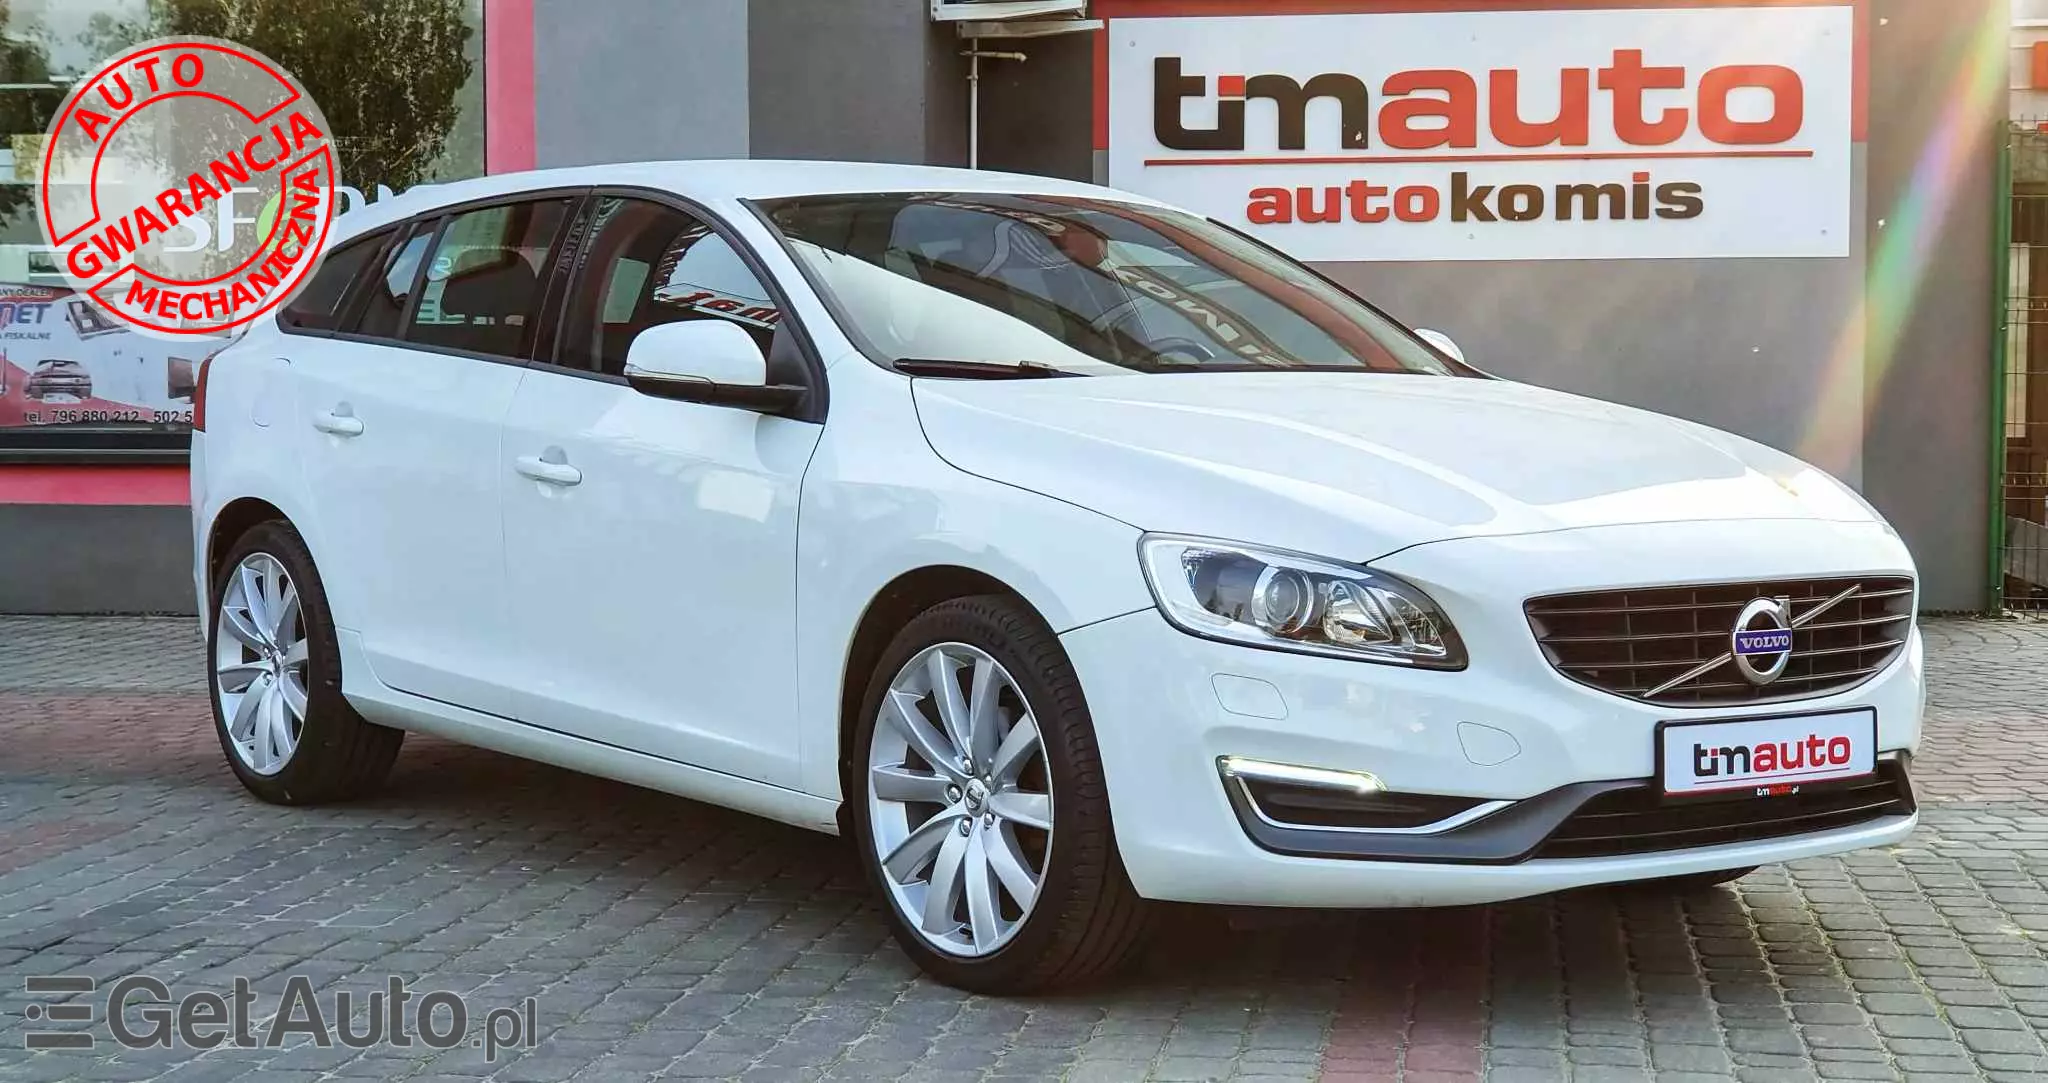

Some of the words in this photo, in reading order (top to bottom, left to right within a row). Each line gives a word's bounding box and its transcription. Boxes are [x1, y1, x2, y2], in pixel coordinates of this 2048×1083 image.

[1153, 48, 1804, 151] timauto
[51, 410, 77, 423] 796
[82, 410, 108, 422] 880
[115, 410, 139, 422] 212
[154, 410, 179, 423] 502
[1740, 634, 1790, 650] VOLVO
[1693, 733, 1851, 778] timauto
